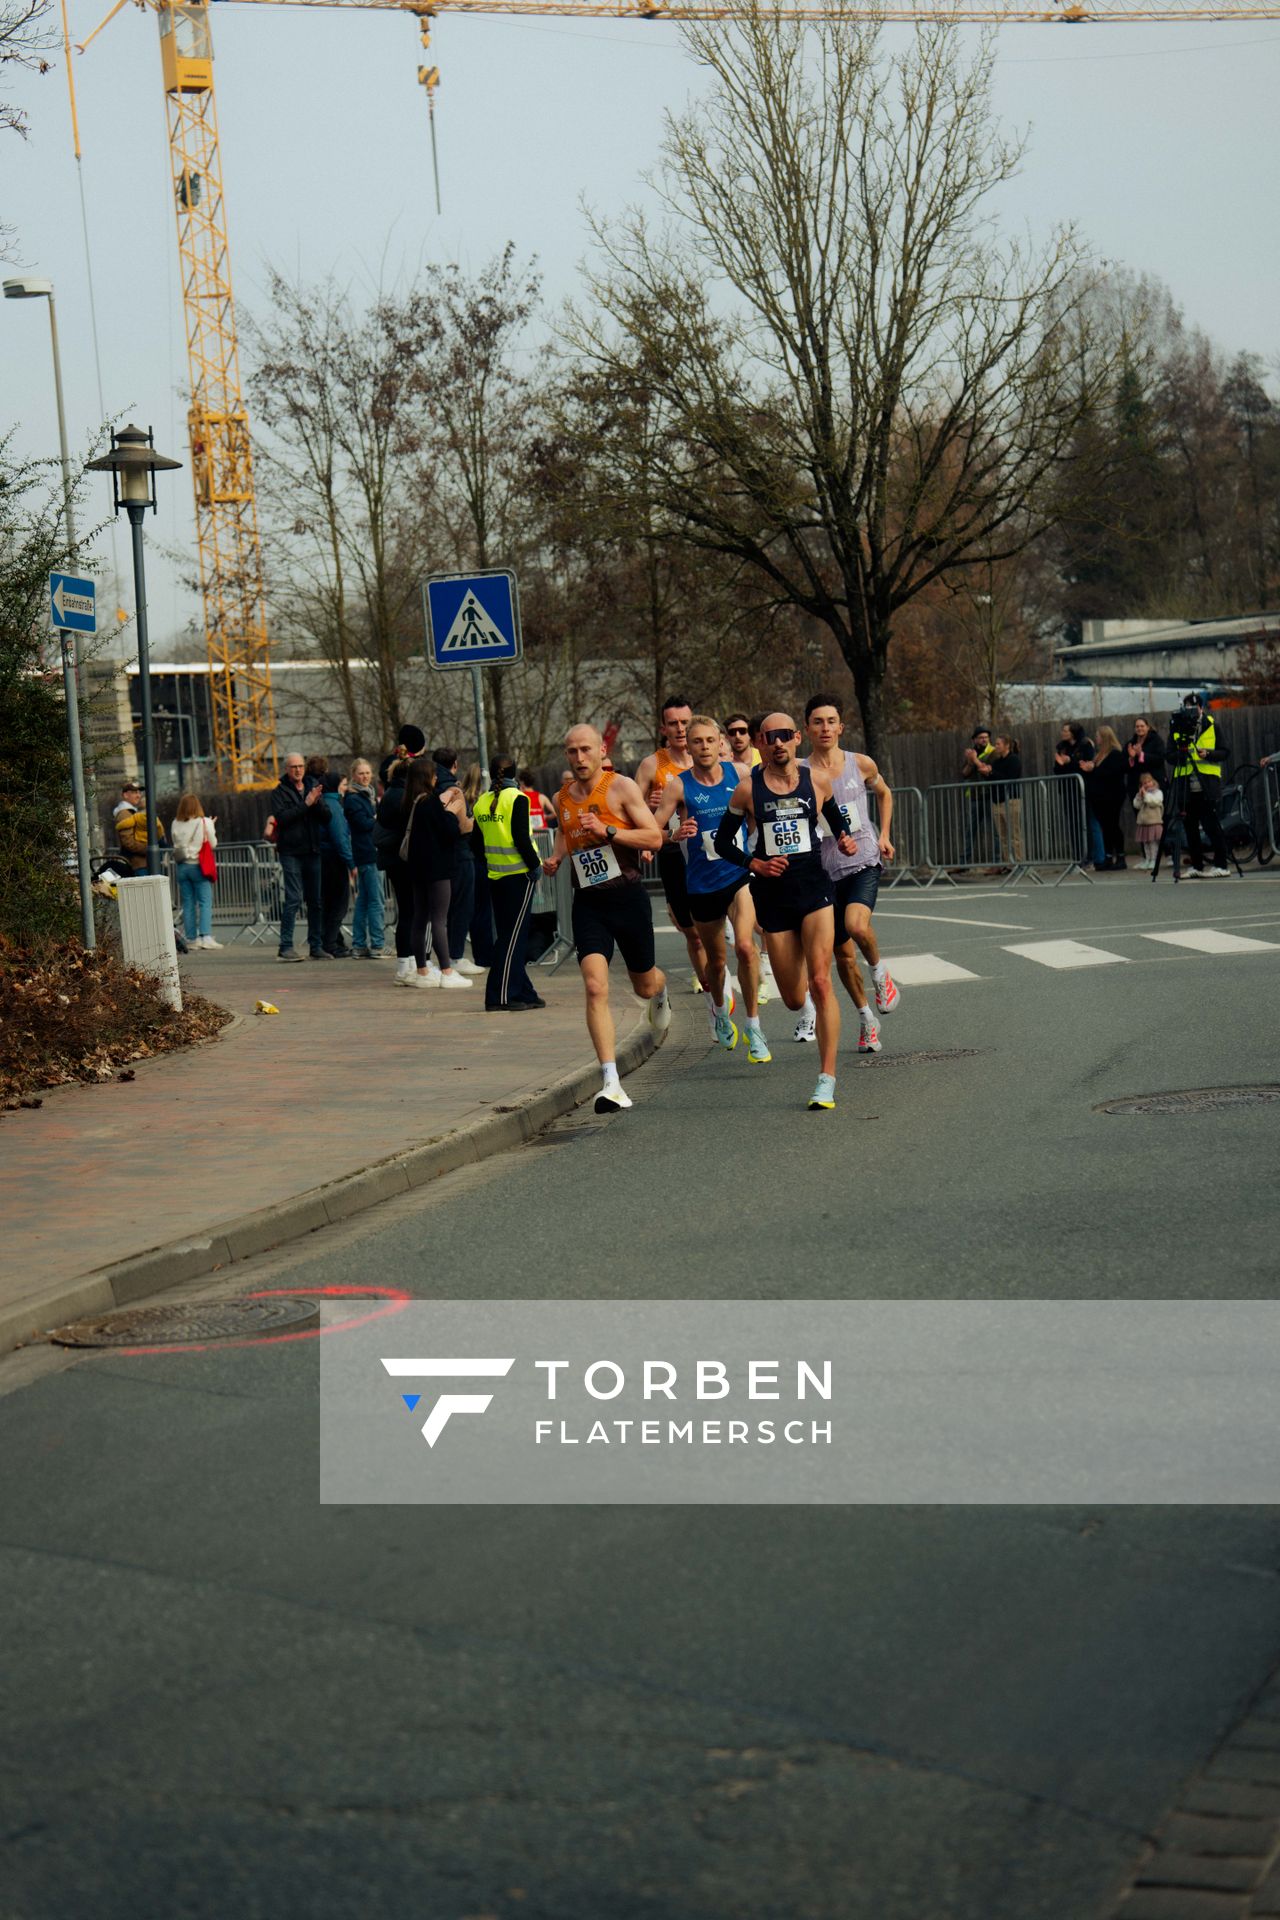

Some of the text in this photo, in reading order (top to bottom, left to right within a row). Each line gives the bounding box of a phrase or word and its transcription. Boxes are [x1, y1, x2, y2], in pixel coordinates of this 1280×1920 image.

[772, 820, 798, 833] GLS
[774, 831, 801, 847] 656
[579, 849, 603, 865] GLS
[583, 859, 608, 877] 200
